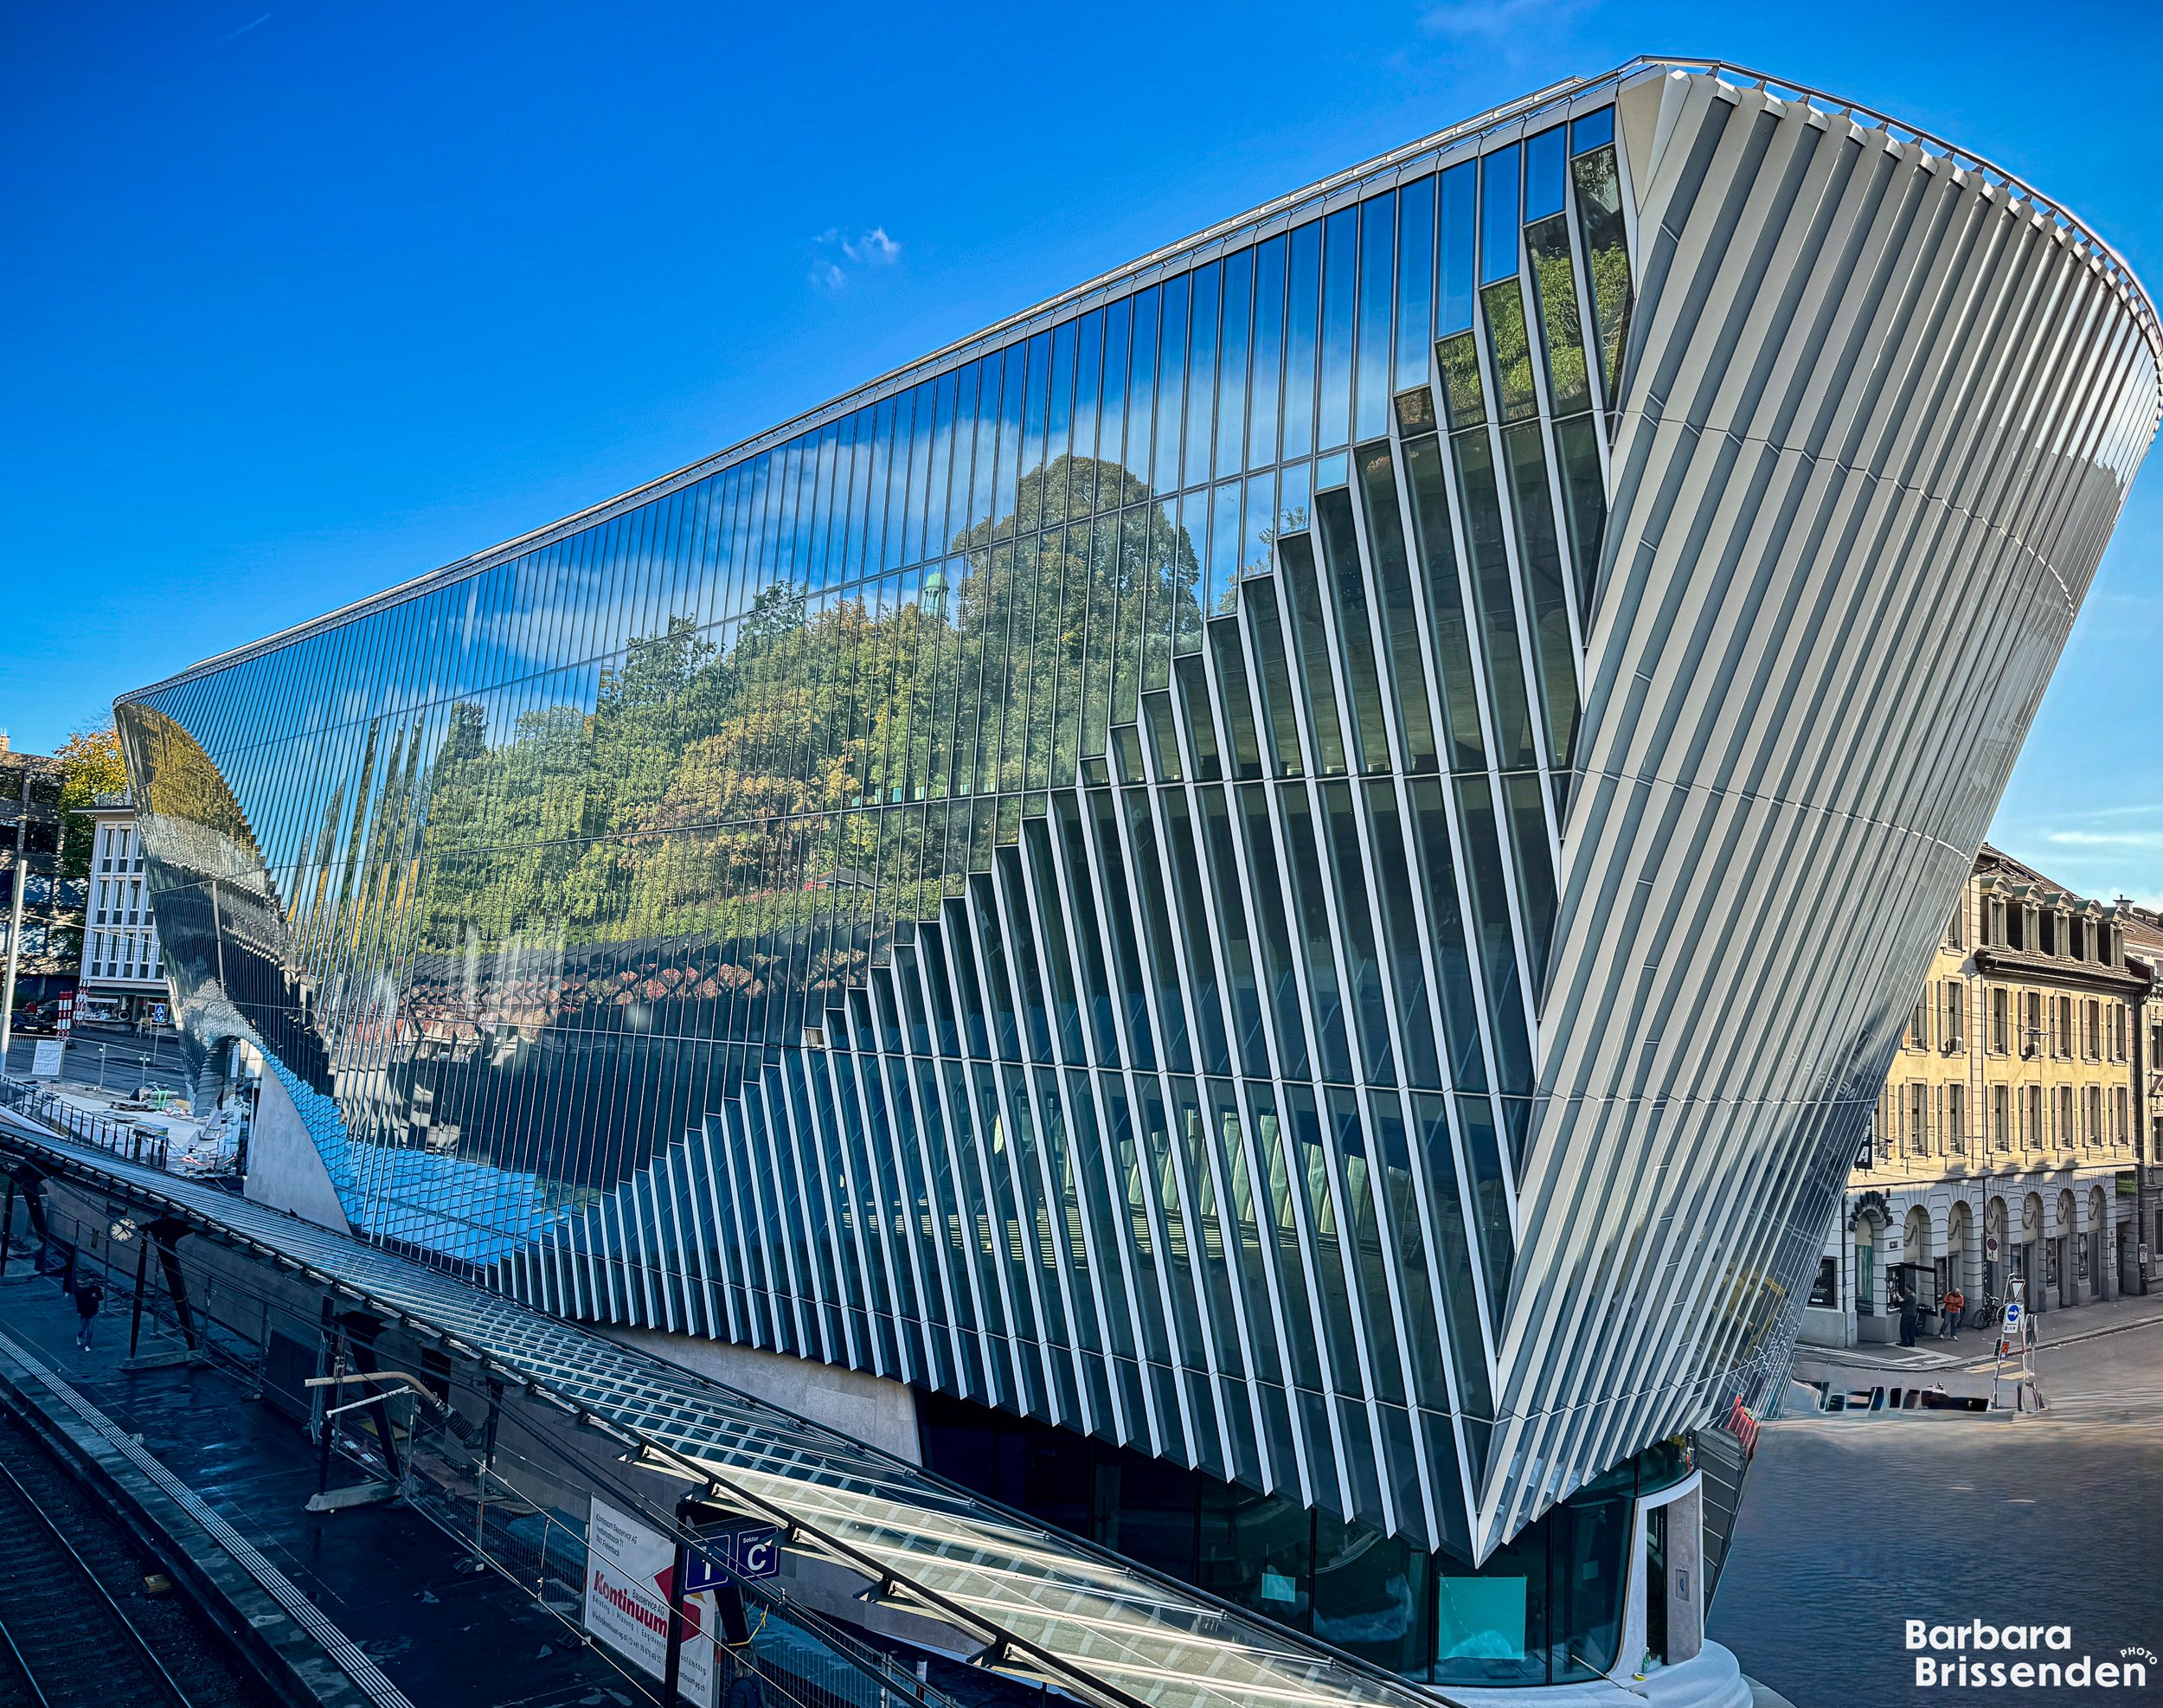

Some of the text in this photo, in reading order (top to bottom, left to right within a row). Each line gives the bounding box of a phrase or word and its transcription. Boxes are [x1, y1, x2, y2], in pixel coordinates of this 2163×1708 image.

[632, 1535, 639, 1544] AG
[748, 1544, 767, 1571] C
[594, 1570, 668, 1639] Kontinuum
[632, 1589, 665, 1616] Bauservice AG
[641, 1629, 666, 1650] Engineerin
[680, 1655, 707, 1677] usführung
